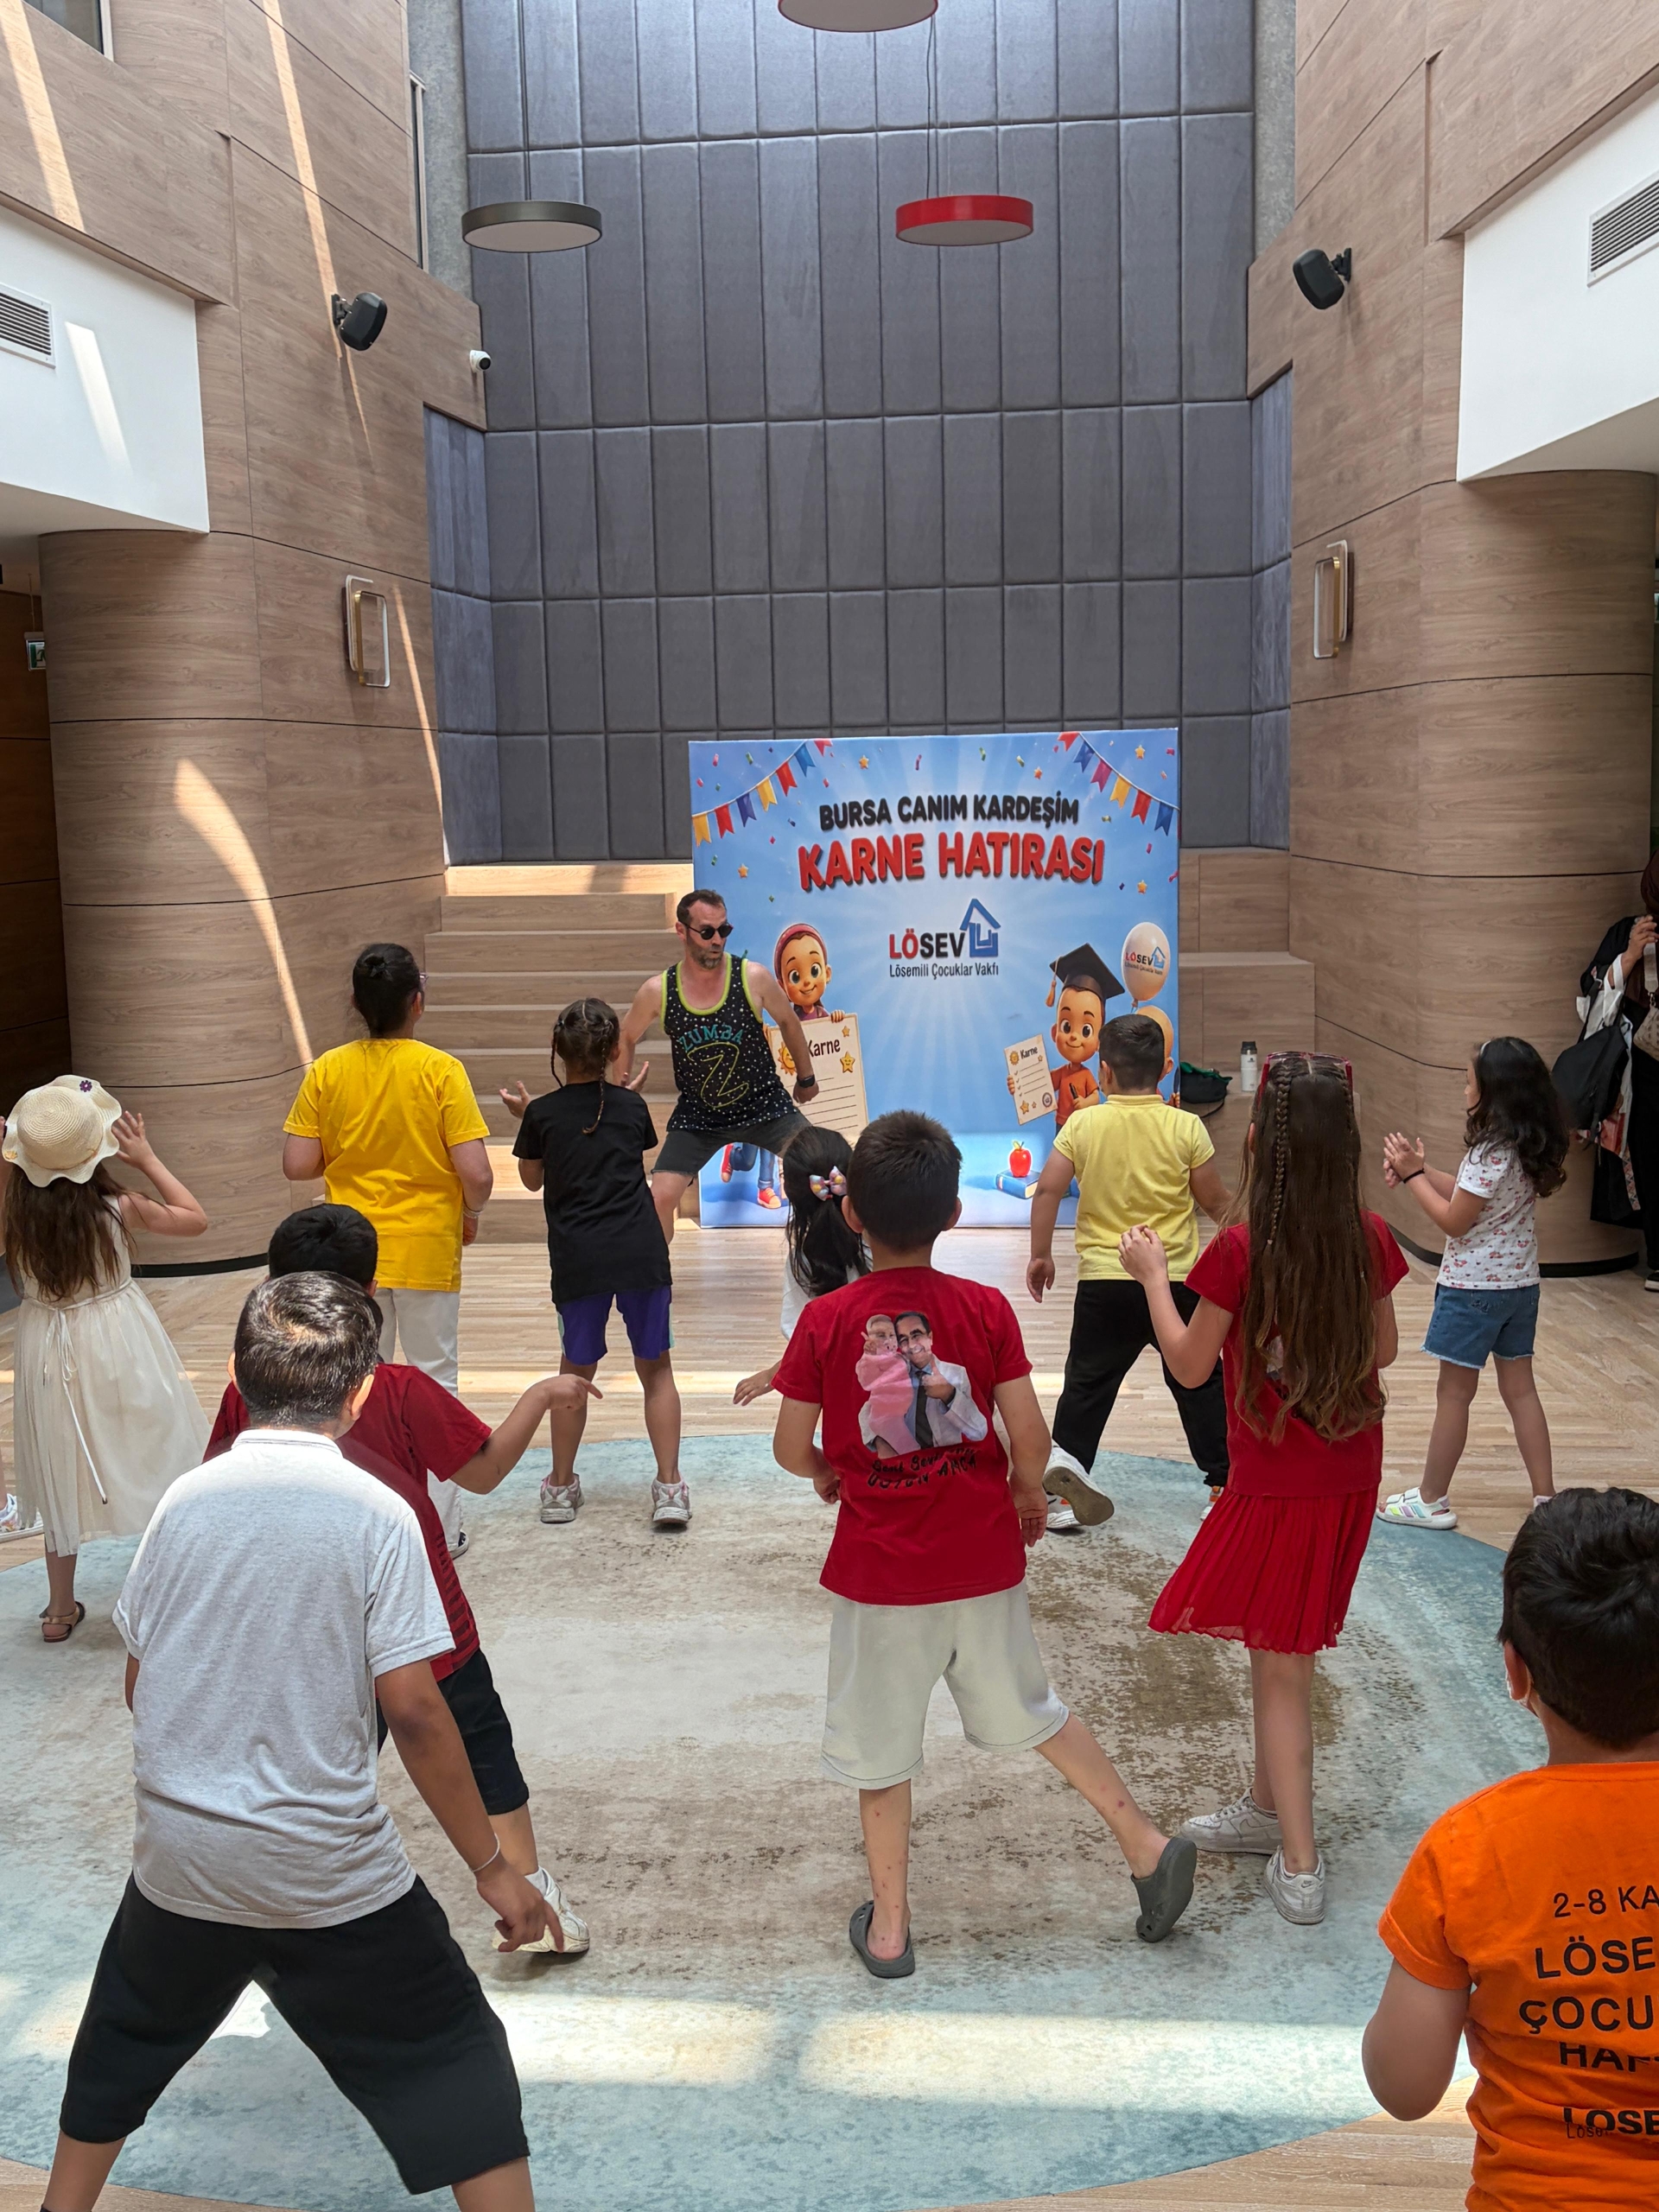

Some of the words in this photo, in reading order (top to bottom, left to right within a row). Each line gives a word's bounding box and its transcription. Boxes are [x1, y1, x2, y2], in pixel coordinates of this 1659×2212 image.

[819, 798, 892, 831] BURSA
[898, 794, 968, 823] CANIM
[973, 791, 1079, 829] KARDEŞİM
[798, 832, 925, 893] KARNE
[938, 830, 1105, 884] HATIRASI
[889, 928, 966, 959] LÖSEV
[889, 963, 929, 977] Lösemili
[931, 963, 973, 980] Çocuklar
[975, 962, 999, 976] Vakfı
[1020, 1046, 1039, 1059] Karne
[1553, 1889, 1606, 1917] 2-8
[1535, 1935, 1656, 1979] LÖSE
[1519, 1995, 1659, 2034] ÇOCU
